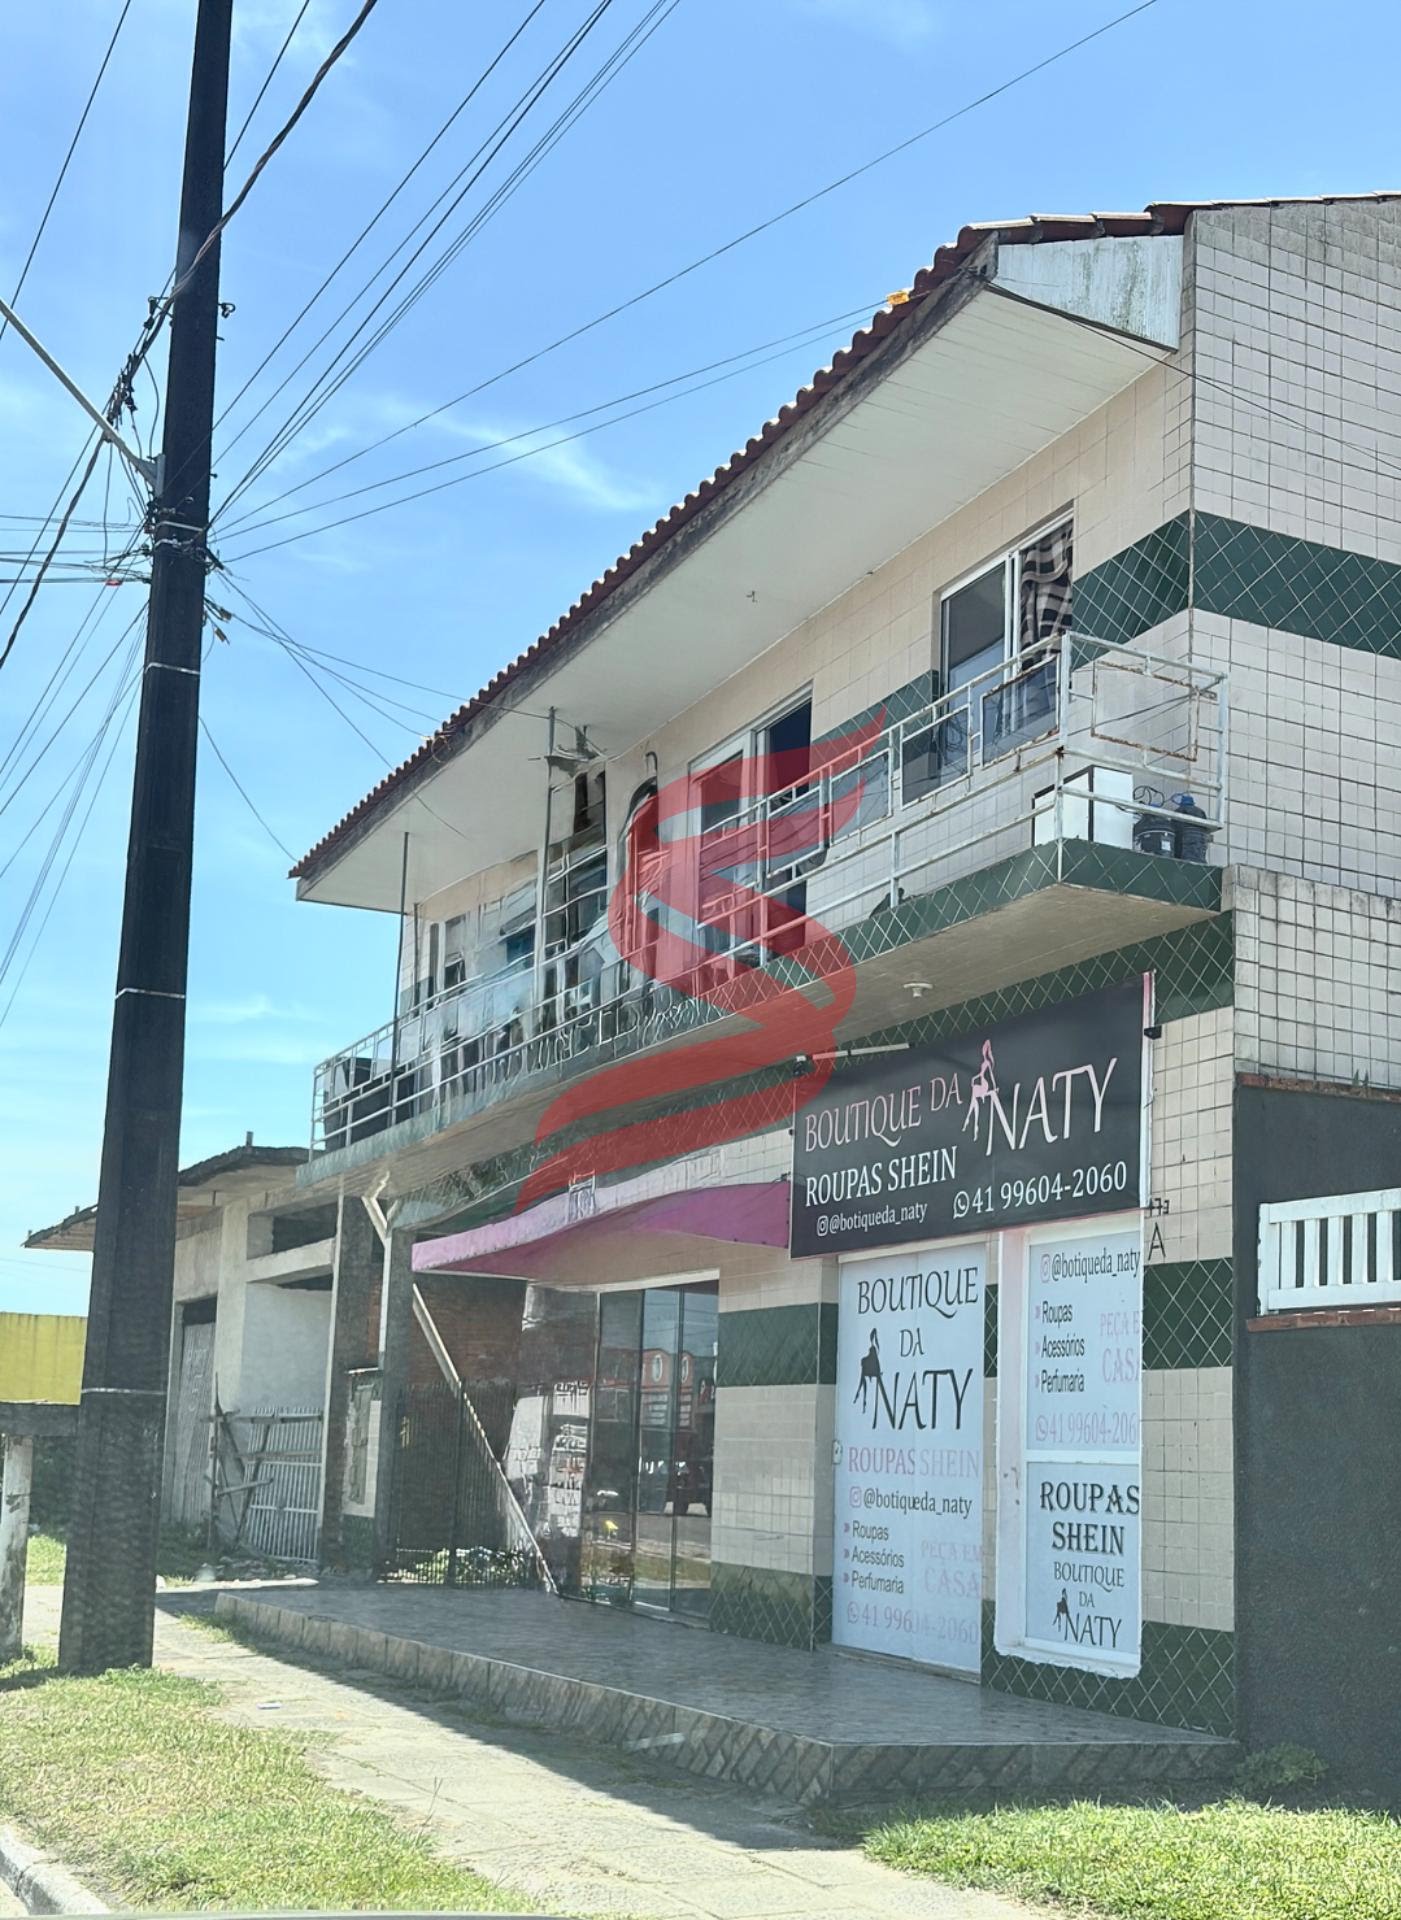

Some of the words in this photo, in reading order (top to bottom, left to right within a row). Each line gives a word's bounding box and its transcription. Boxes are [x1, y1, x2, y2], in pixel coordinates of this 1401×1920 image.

[805, 1086, 922, 1152] BOUTIQUE
[930, 1072, 963, 1111] DA
[986, 1057, 1117, 1156] NATY
[805, 1162, 883, 1207] ROUPAS
[887, 1145, 957, 1191] SHEIN
[972, 1186, 994, 1214] 41
[1000, 1161, 1127, 1209] 99604-2060
[829, 1202, 928, 1234] @botiqueda_naty
[1148, 1222, 1166, 1261] A
[1052, 1247, 1140, 1283] @botiqueda_naty
[857, 1266, 979, 1319] BOUTIQUE
[1042, 1301, 1073, 1328] Roupas
[900, 1327, 925, 1357] DA
[1041, 1333, 1085, 1359] Acessórios
[1041, 1368, 1085, 1394] Perfumaria
[872, 1368, 974, 1430] NATY
[1049, 1412, 1064, 1443] 41
[848, 1446, 915, 1475] ROUPAS
[920, 1449, 980, 1479] SHEIN
[864, 1488, 973, 1519] @botiqueda_naty
[1040, 1481, 1139, 1515] ROUPAS
[852, 1520, 889, 1543] Roupas
[1052, 1521, 1125, 1555] SHEIN
[852, 1546, 905, 1568] Acessórios
[852, 1570, 904, 1594] Perfumaria
[1054, 1561, 1125, 1593] BOUTIQUE
[862, 1604, 878, 1627] 41
[1078, 1591, 1095, 1608] DA
[1064, 1612, 1122, 1648] NATY
